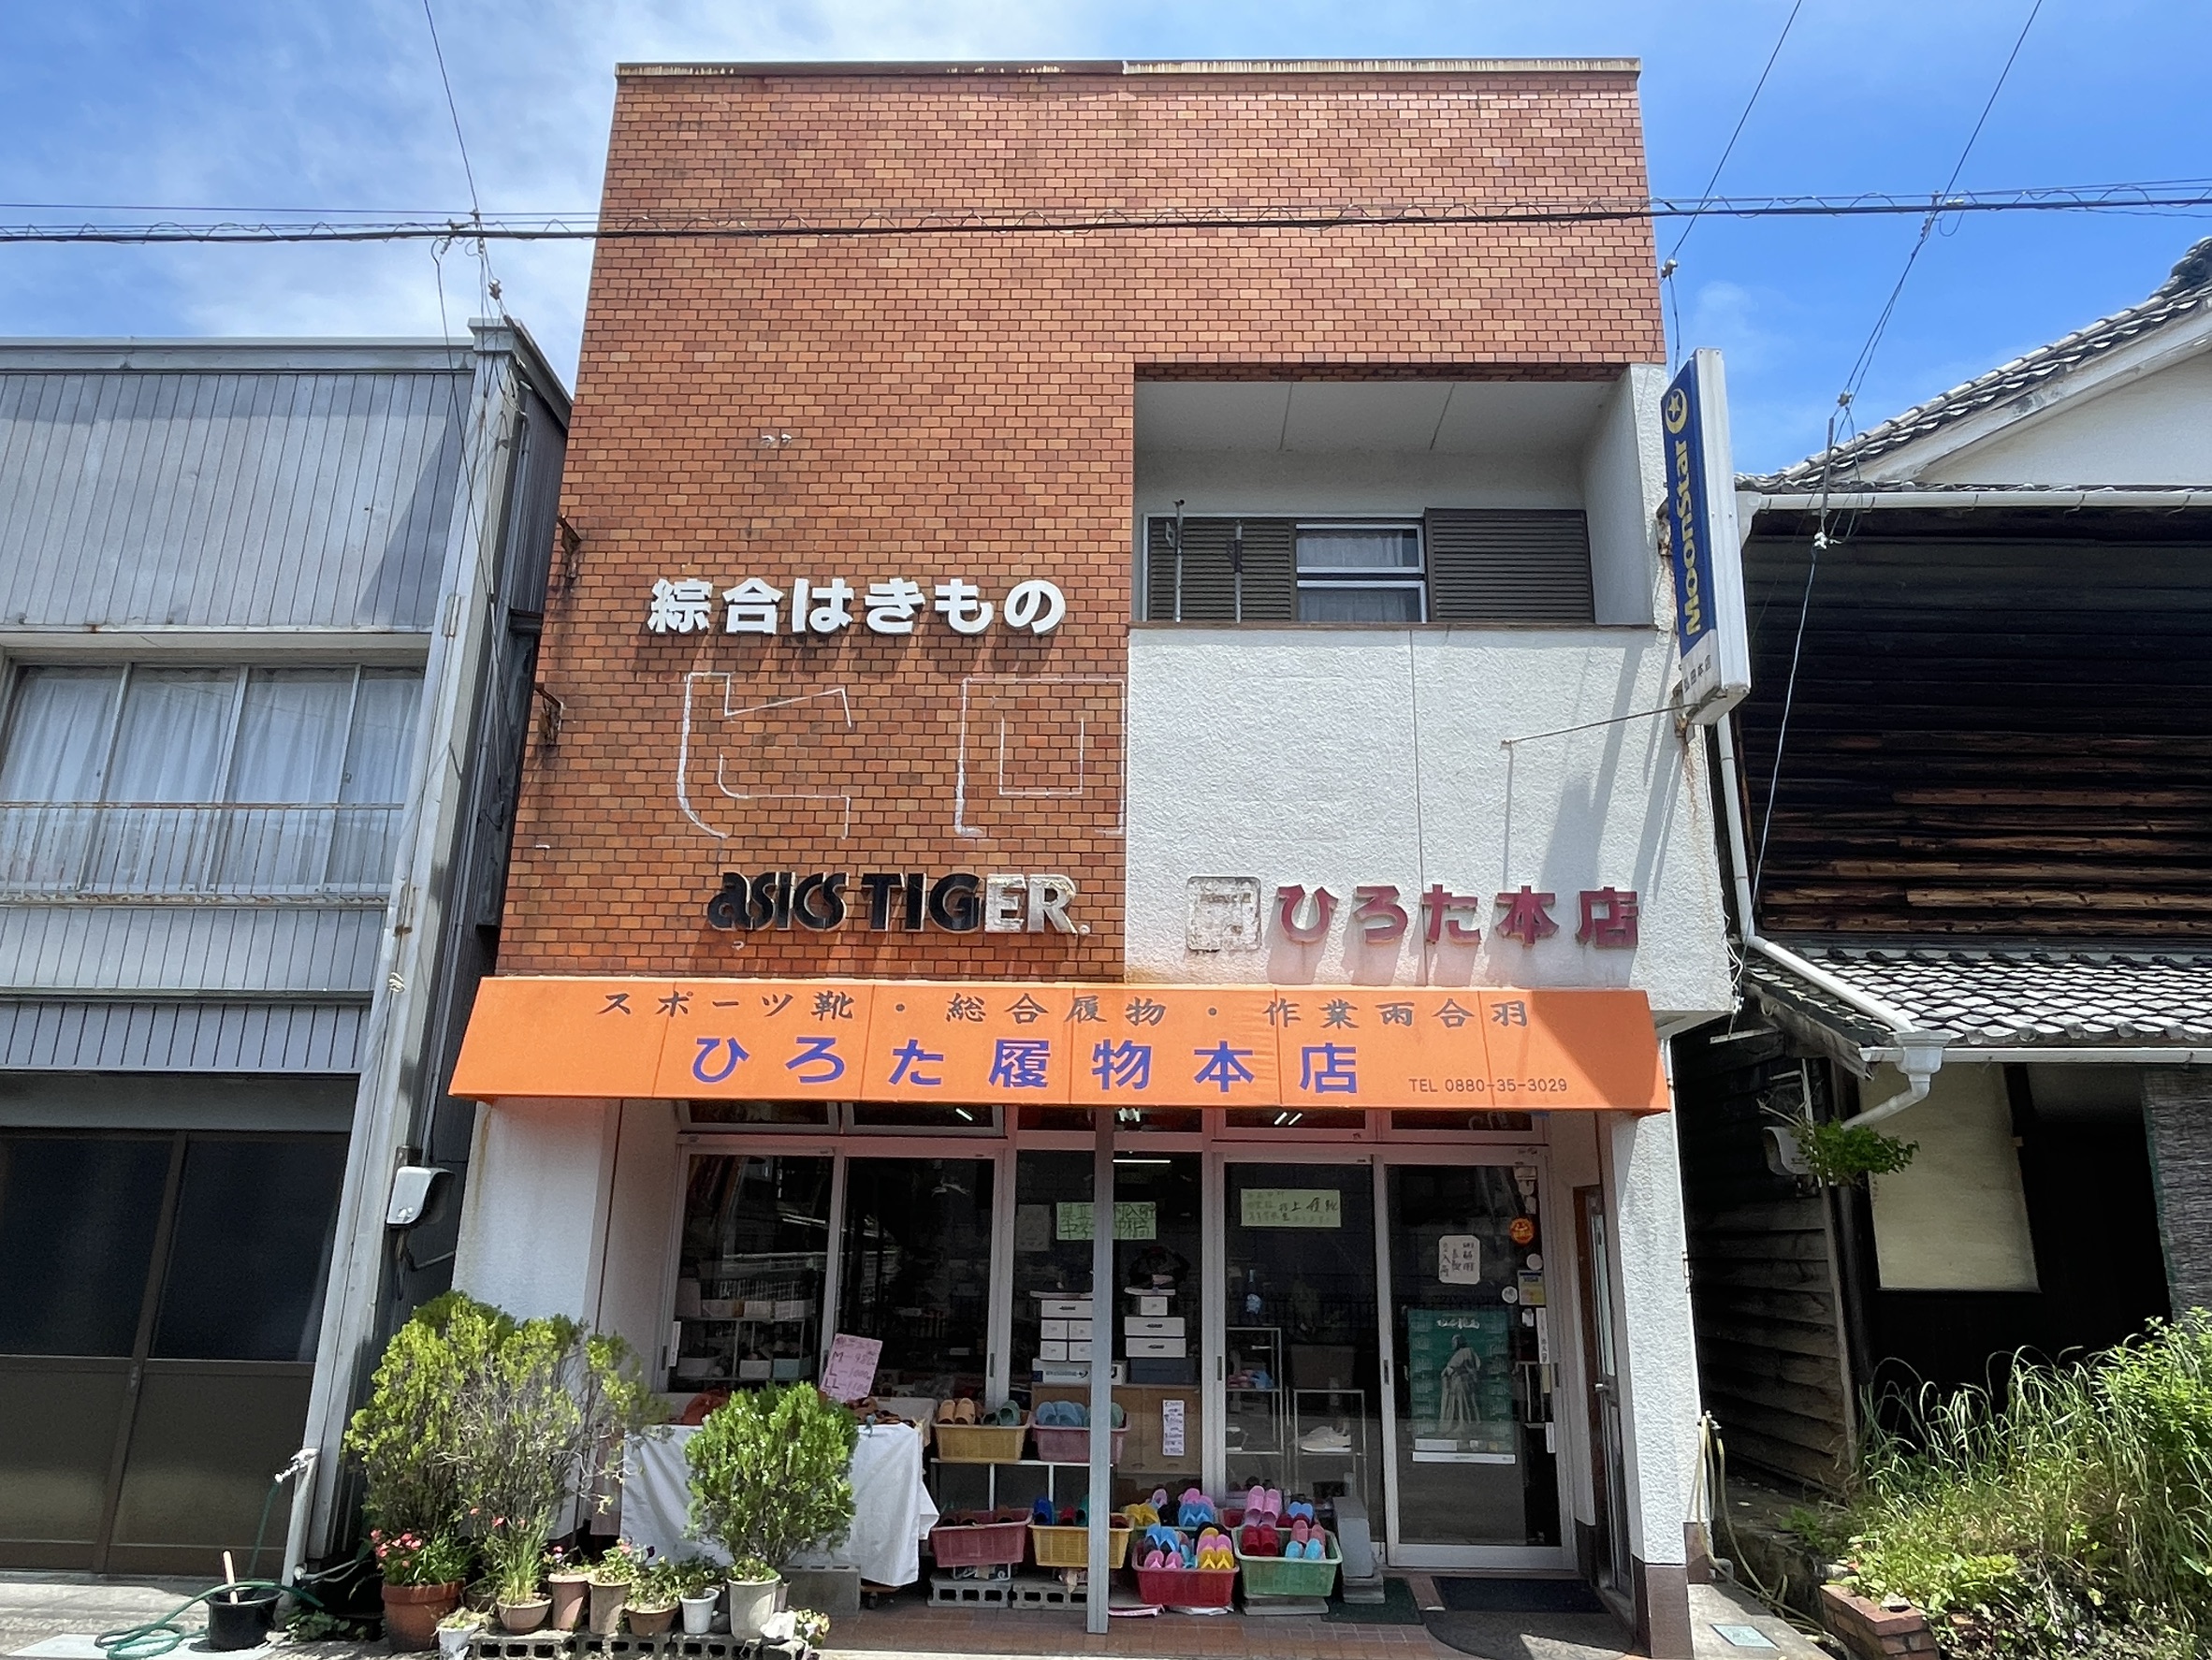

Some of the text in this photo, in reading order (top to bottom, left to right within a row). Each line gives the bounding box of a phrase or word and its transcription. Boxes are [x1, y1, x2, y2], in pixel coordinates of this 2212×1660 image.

[1675, 440, 1701, 635] MoonStar
[648, 576, 1066, 636] 綜合はきもの
[1276, 883, 1638, 948] ひろた本店
[691, 1036, 1358, 1095] ひろた履物本店
[1408, 1077, 1568, 1093] TEL 0880-35-3029
